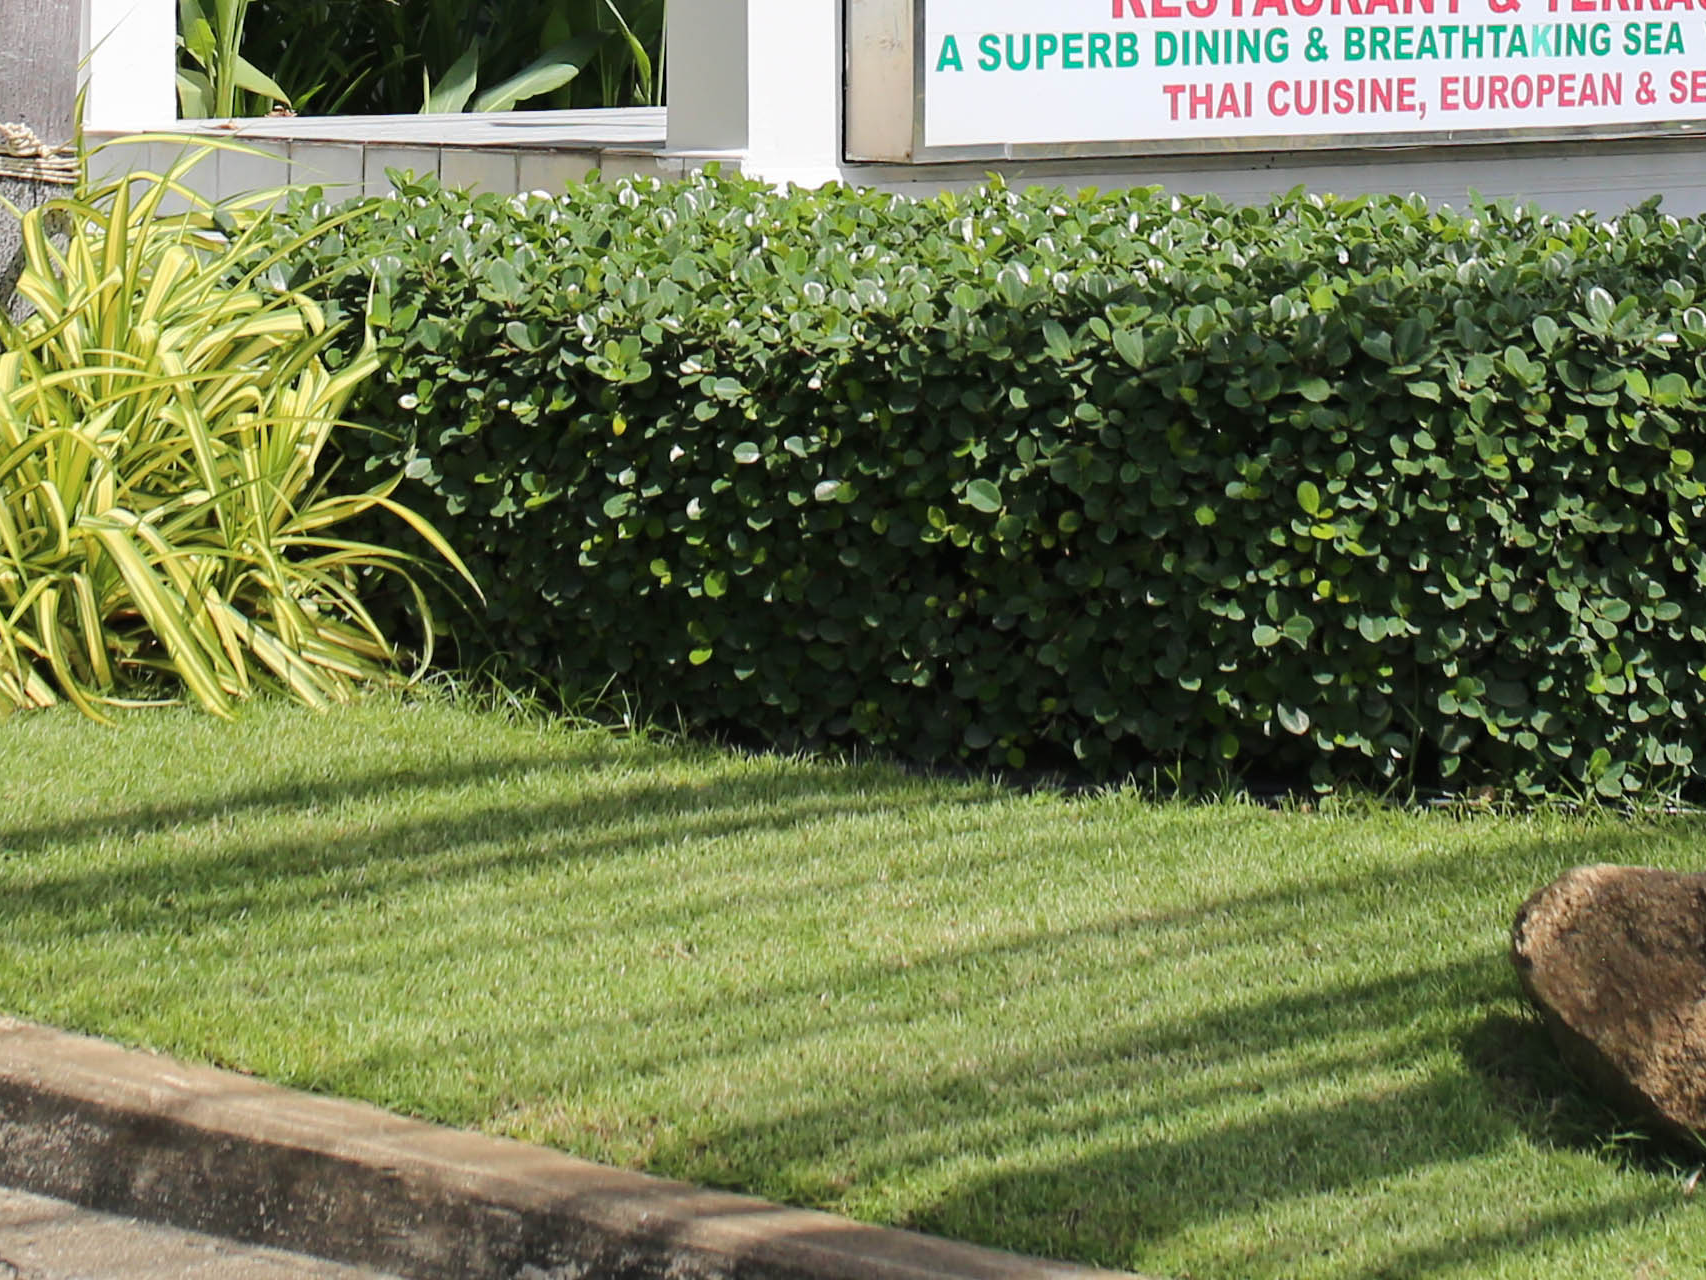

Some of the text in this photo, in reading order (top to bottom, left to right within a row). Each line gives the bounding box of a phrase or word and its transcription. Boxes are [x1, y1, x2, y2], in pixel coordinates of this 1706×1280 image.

[936, 35, 964, 72] A
[978, 31, 1140, 72] SUPERB
[1154, 27, 1289, 67] DINING
[1304, 26, 1330, 63] &
[1344, 23, 1611, 62] BREATHTAKING
[1623, 21, 1686, 56] SEA
[1162, 82, 1252, 121] THAI
[1267, 77, 1426, 120] CUISINE,
[1440, 72, 1622, 111] EUROPEAN
[1635, 71, 1657, 105] &
